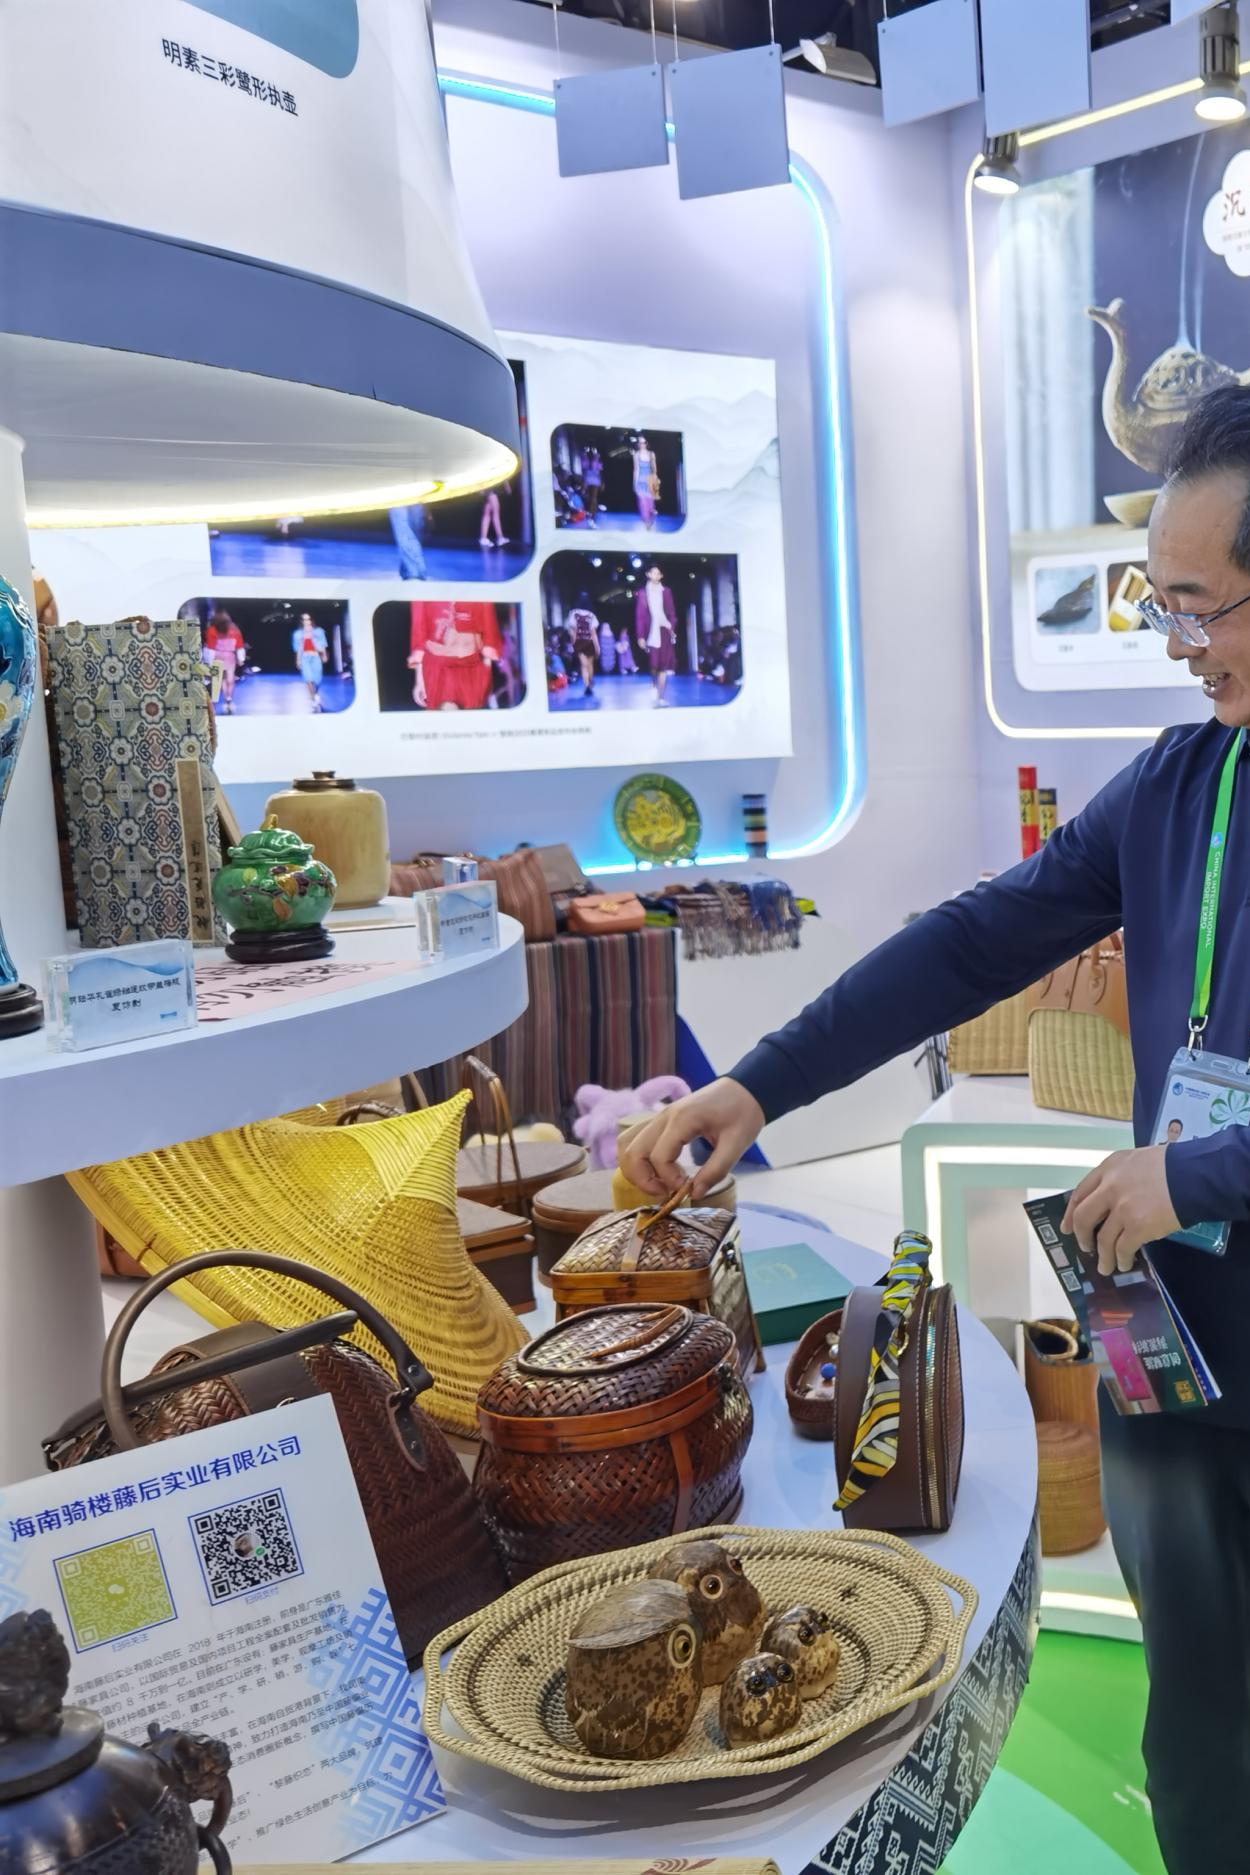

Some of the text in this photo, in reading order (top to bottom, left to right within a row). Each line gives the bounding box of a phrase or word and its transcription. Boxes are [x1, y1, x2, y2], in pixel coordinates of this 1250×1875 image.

[1212, 851, 1221, 879] CHINA
[9, 1435, 302, 1542] 海南骑楼藤后实业有限公司
[187, 1636, 212, 1653] 2018
[125, 1696, 134, 1707] 8
